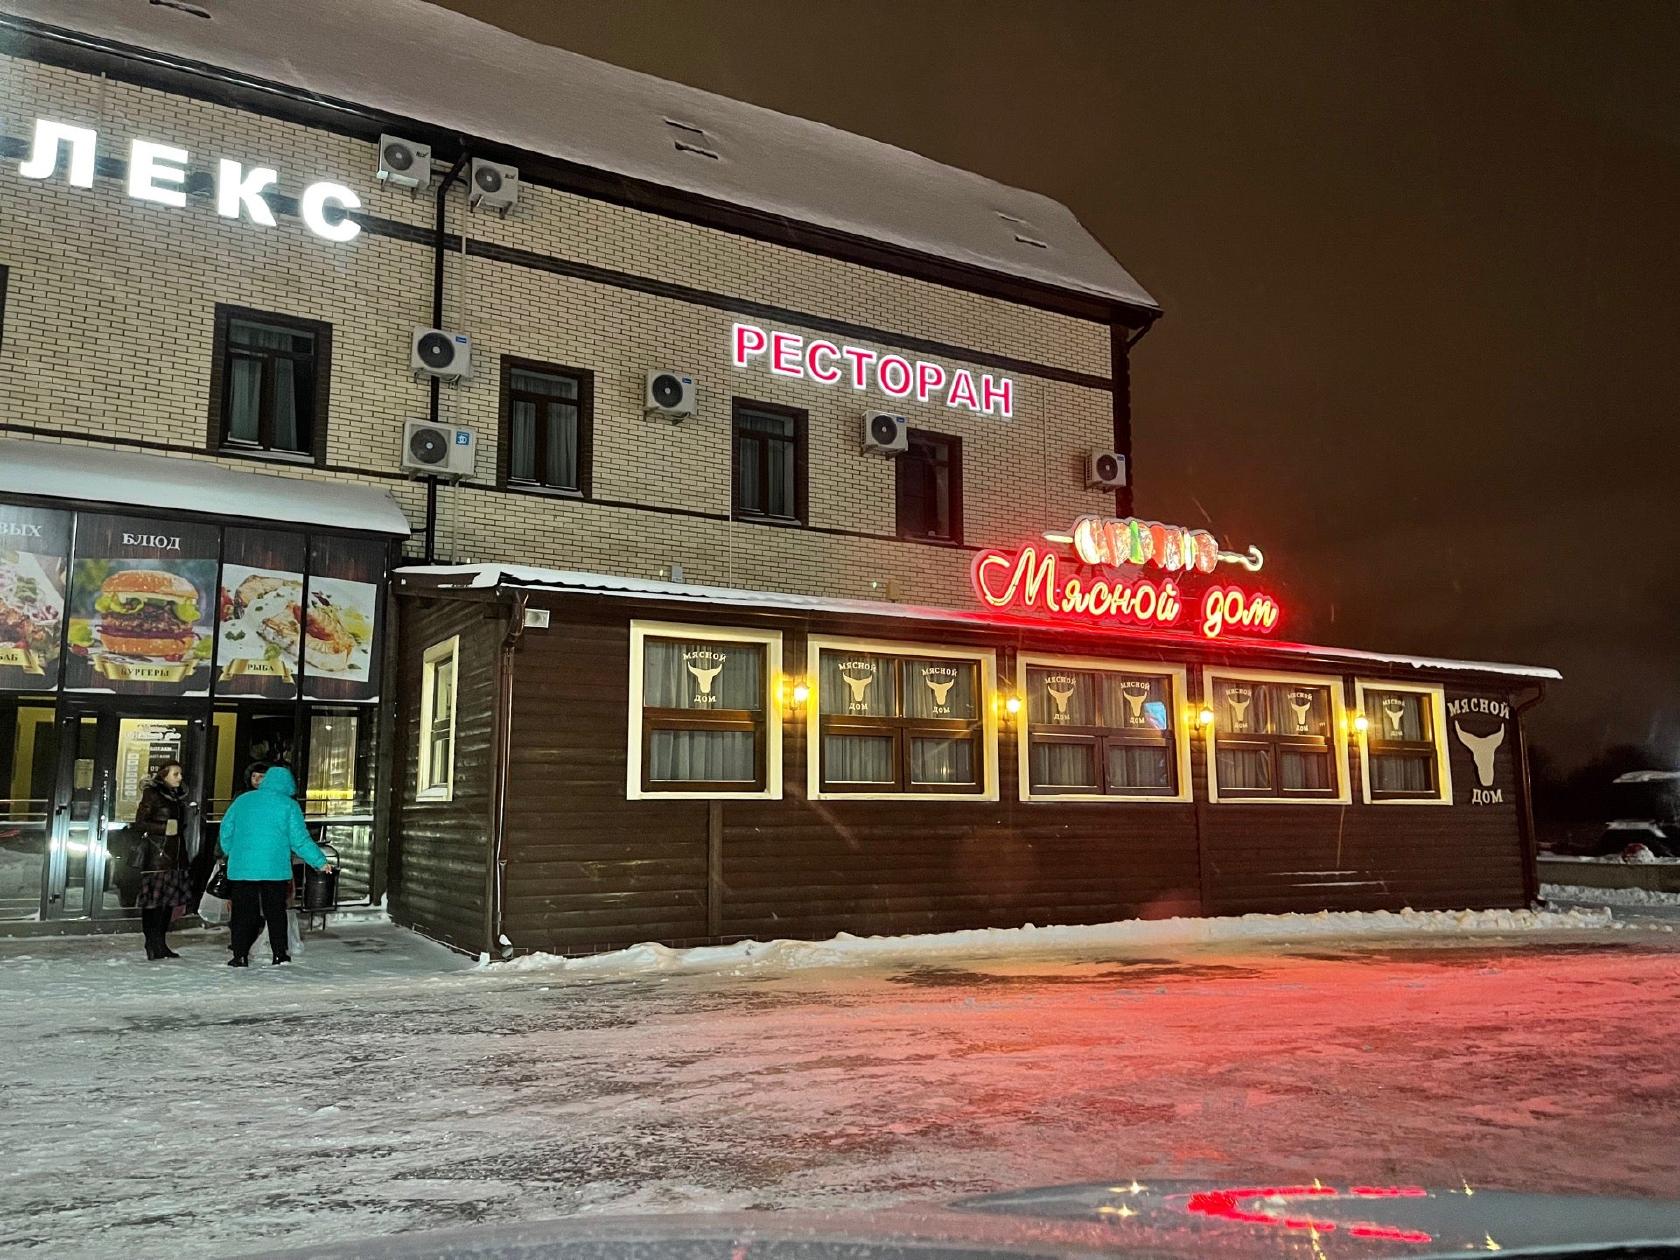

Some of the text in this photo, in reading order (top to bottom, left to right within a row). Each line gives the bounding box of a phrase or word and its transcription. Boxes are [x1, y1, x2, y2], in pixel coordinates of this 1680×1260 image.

[19, 118, 362, 242] ЛЕКС
[732, 322, 1013, 418] РЕСТОРАН
[122, 533, 181, 550] БЛЮД
[978, 547, 1180, 621] Мясной
[682, 651, 727, 662] МЯСНОЙ
[120, 667, 170, 677] БУРГЕРЫ
[247, 662, 275, 672] РЫБА
[838, 661, 877, 672] МЯСНОЙ
[921, 667, 958, 676] МЯСНОЙ
[1045, 676, 1076, 685] МЯСНОЙ
[1120, 681, 1150, 690] МЯСНОЙ
[693, 694, 717, 703] ДОМ
[848, 702, 869, 710] ДОМ
[1447, 698, 1510, 719] МЯСНОЙ
[1471, 789, 1504, 806] ДОМ
